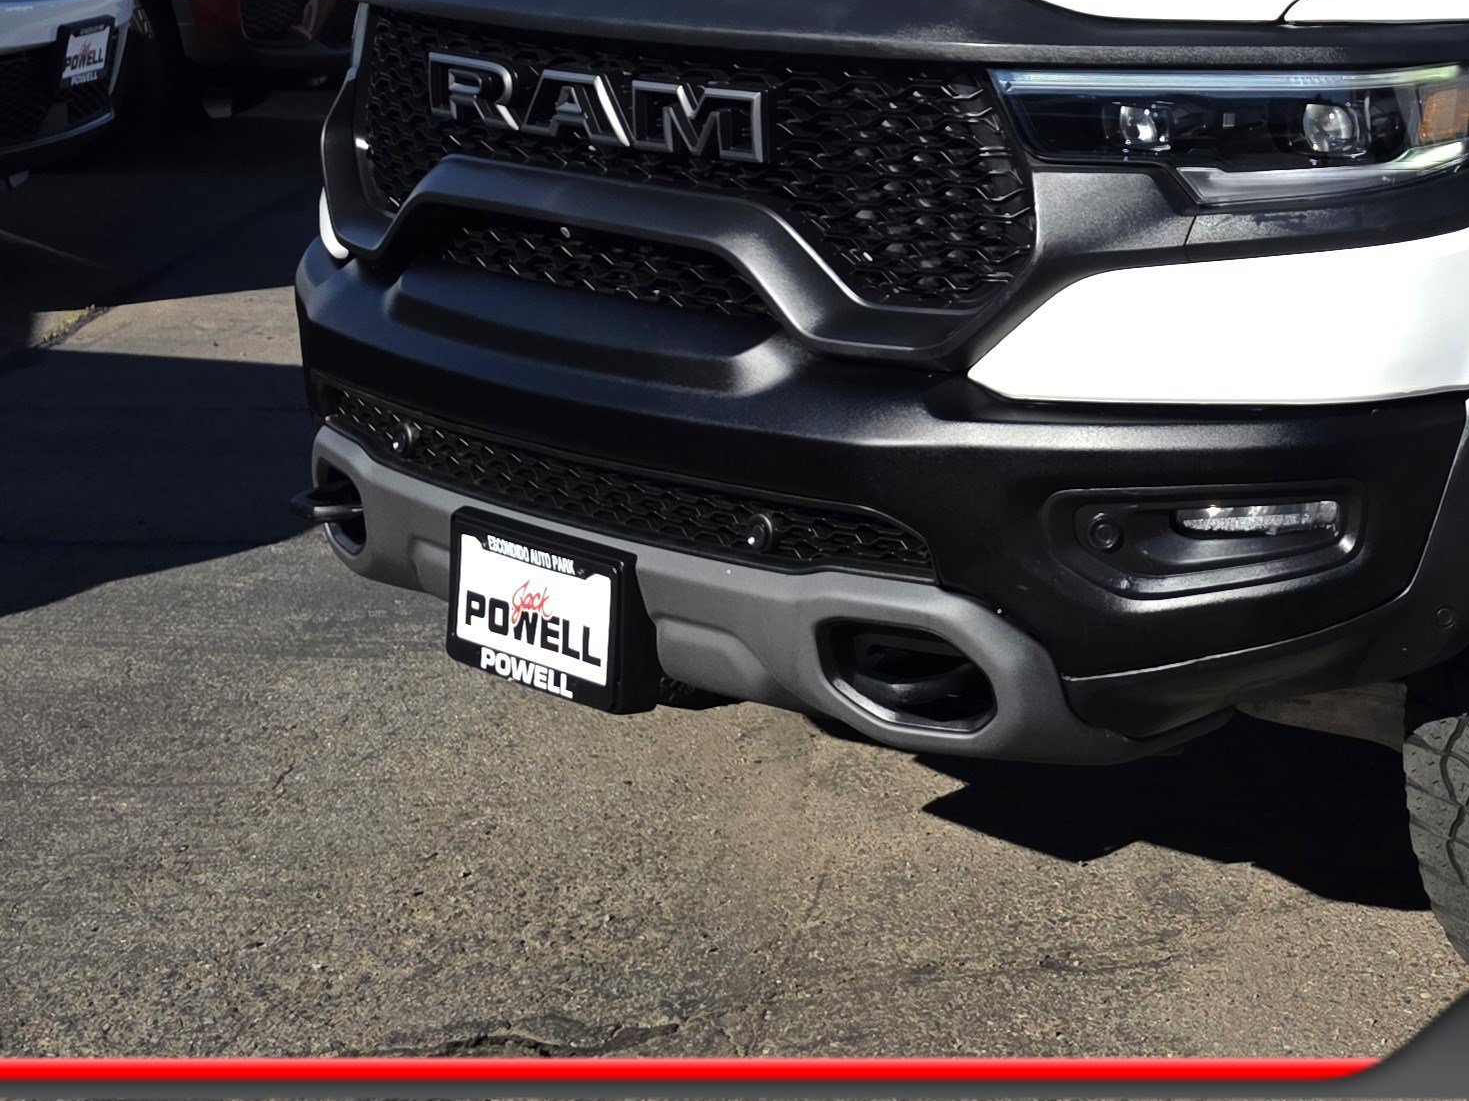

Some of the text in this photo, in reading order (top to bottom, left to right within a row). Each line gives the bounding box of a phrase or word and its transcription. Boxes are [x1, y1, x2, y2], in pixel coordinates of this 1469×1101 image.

[64, 47, 104, 71] POWELL
[428, 51, 771, 164] RAM
[486, 534, 576, 575] ESCONDIDO AUTO PARK
[511, 579, 553, 624] Jack
[465, 590, 602, 668] POWELL
[480, 646, 574, 699] POWELL
